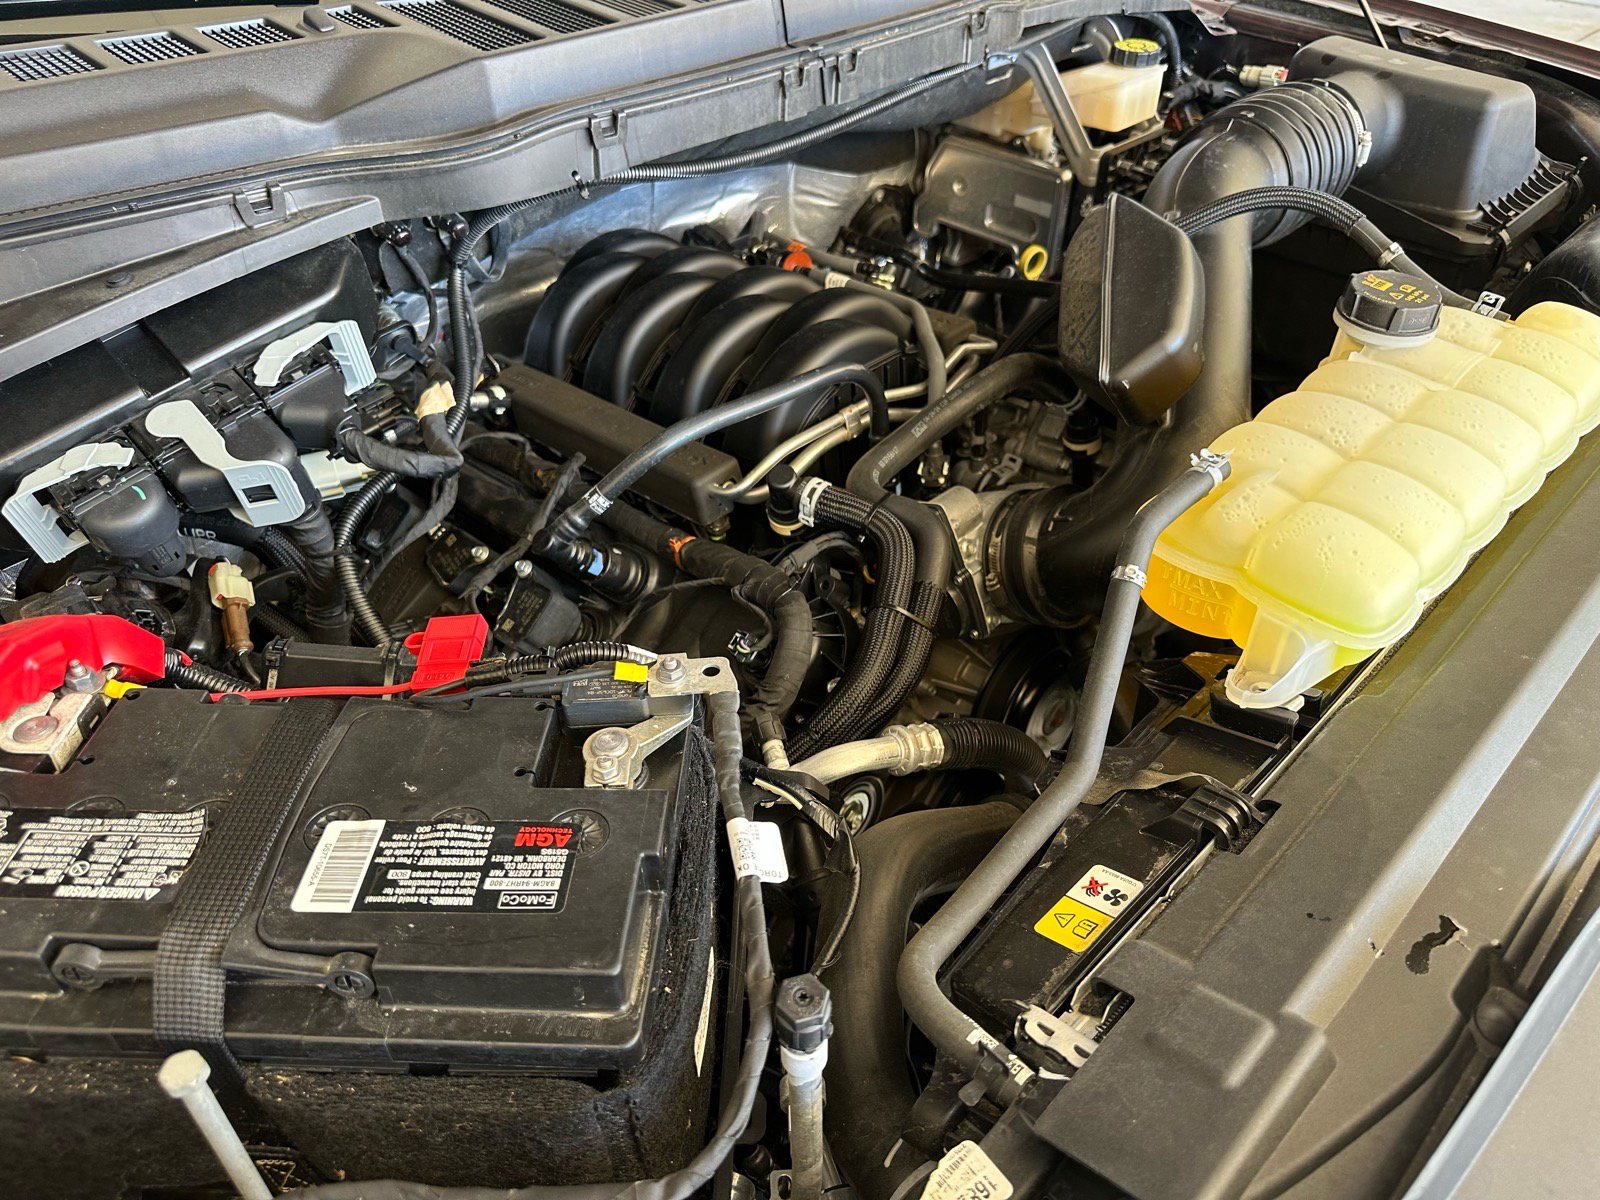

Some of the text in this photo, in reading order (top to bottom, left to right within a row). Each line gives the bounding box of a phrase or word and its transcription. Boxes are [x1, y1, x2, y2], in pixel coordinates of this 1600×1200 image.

[514, 833, 571, 847] AGM
[393, 848, 414, 856] guide
[411, 869, 433, 878] amps
[434, 869, 463, 879] cranking
[463, 871, 481, 879] Cold
[442, 879, 460, 887] start
[53, 885, 144, 899] DANGER/POISON
[394, 886, 415, 895] guide
[364, 894, 473, 906] WARNING: To avoid personal
[502, 894, 555, 904] FoMoCo
